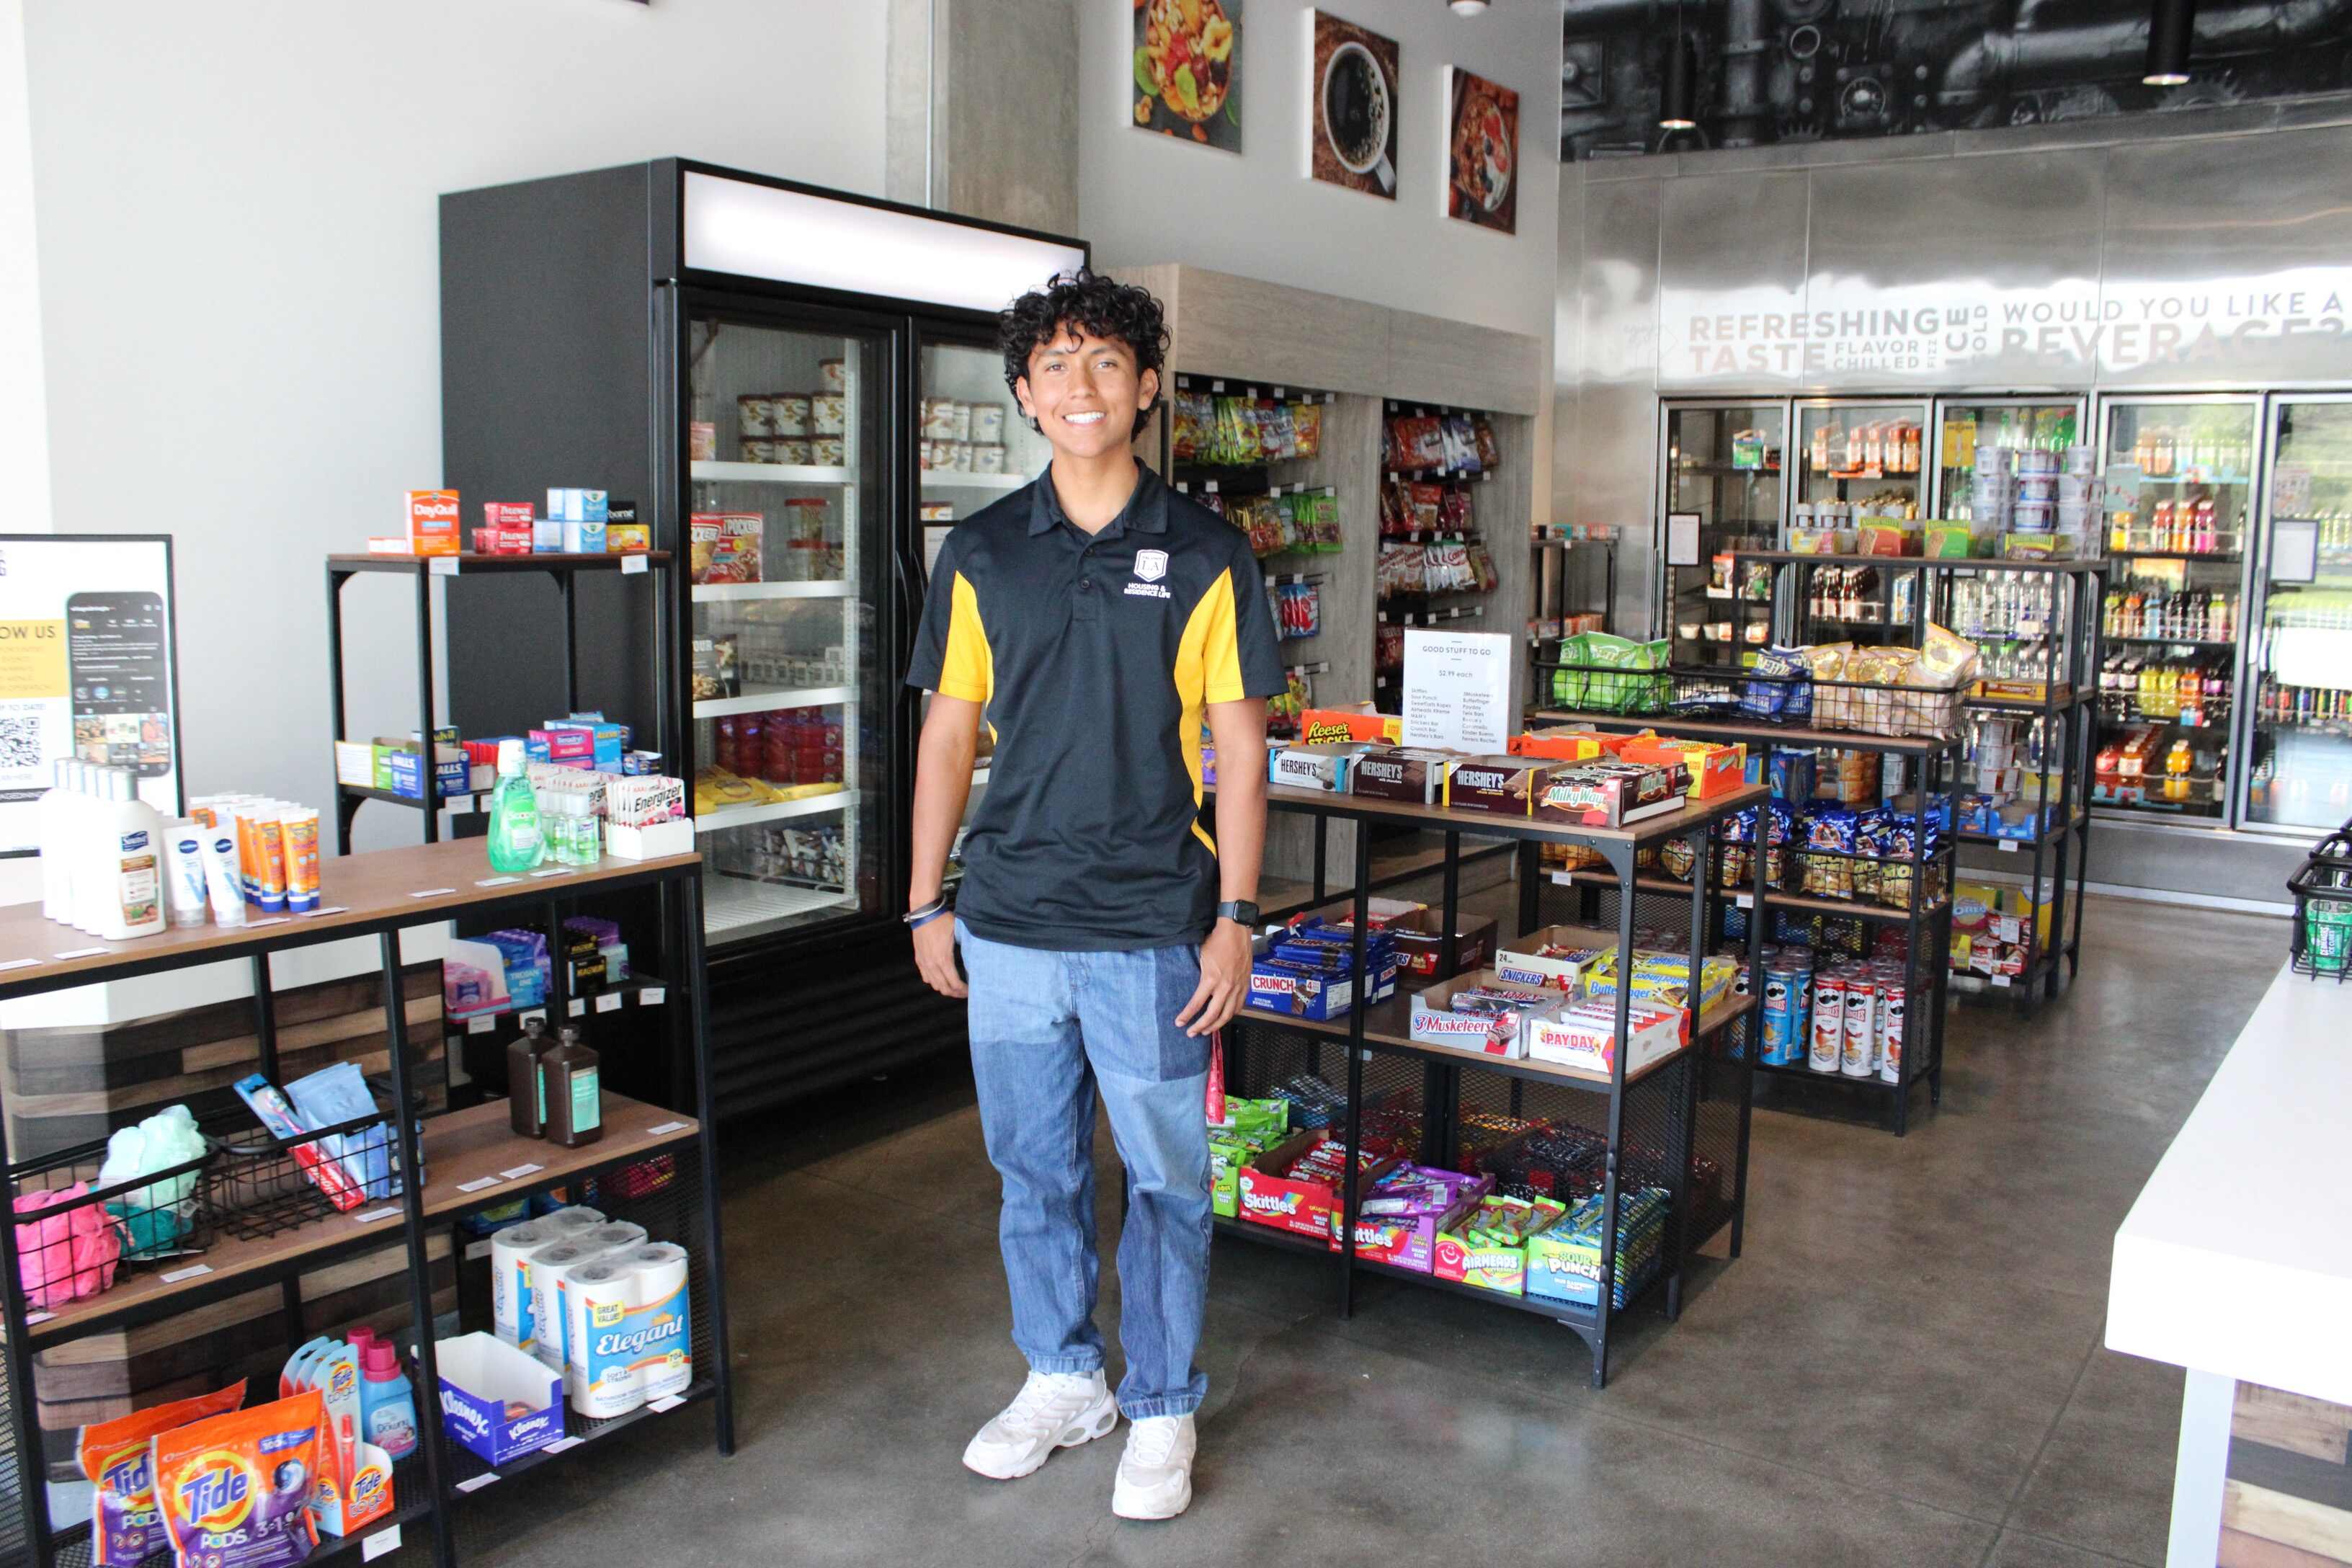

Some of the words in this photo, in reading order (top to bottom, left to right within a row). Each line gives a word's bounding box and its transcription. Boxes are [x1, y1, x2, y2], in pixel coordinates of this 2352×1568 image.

[2003, 300, 2123, 323] WOULD
[2139, 296, 2209, 319] YOU
[2227, 292, 2306, 316] LIKE
[2321, 290, 2345, 313] A
[1689, 308, 1940, 342] REFRESHING
[1946, 307, 1969, 365] ICE
[1835, 340, 1919, 355] FLAVOR
[1689, 343, 1827, 373] TASTE
[1833, 356, 1919, 371] CHILLED
[414, 504, 458, 518] DayQuil
[1124, 588, 1159, 597] RESIDENCE
[1128, 582, 1159, 591] HOUSING
[35, 625, 56, 639] US
[1309, 721, 1350, 738] Reese's
[437, 762, 463, 775] ALLS
[1280, 758, 1317, 777] HERSHEY'S
[1361, 760, 1403, 779] HERSHEY'S
[1456, 770, 1505, 788] HERSHEY'S
[634, 784, 682, 814] Energizer
[1499, 953, 1507, 962] 24
[510, 970, 540, 979] TROJAN
[1500, 969, 1543, 985] SNICKERS
[1252, 976, 1294, 992] CRUNCH
[1306, 980, 1312, 990] 4
[1816, 1004, 1839, 1017] PRINGLES
[1415, 1013, 1425, 1030] 3
[1425, 1015, 1492, 1033] Musketeers
[1545, 1033, 1595, 1049] PAYDAY
[1244, 1193, 1296, 1216] Skittles
[1335, 1225, 1394, 1248] Sittles
[1462, 1253, 1519, 1271] AIRHEADS
[1559, 1251, 1592, 1266] SOUR
[1548, 1257, 1600, 1282] PUNCH
[597, 1304, 618, 1314] GREAT
[595, 1314, 685, 1356] Elegant
[331, 1366, 354, 1389] Tide
[439, 1389, 489, 1437] Kleenex
[377, 1419, 409, 1434] Downy
[508, 1416, 550, 1440] Kleenex
[103, 1452, 152, 1497] Tid
[181, 1466, 249, 1526] Tide
[355, 1473, 382, 1501] Tide
[200, 1528, 248, 1549] PODS
